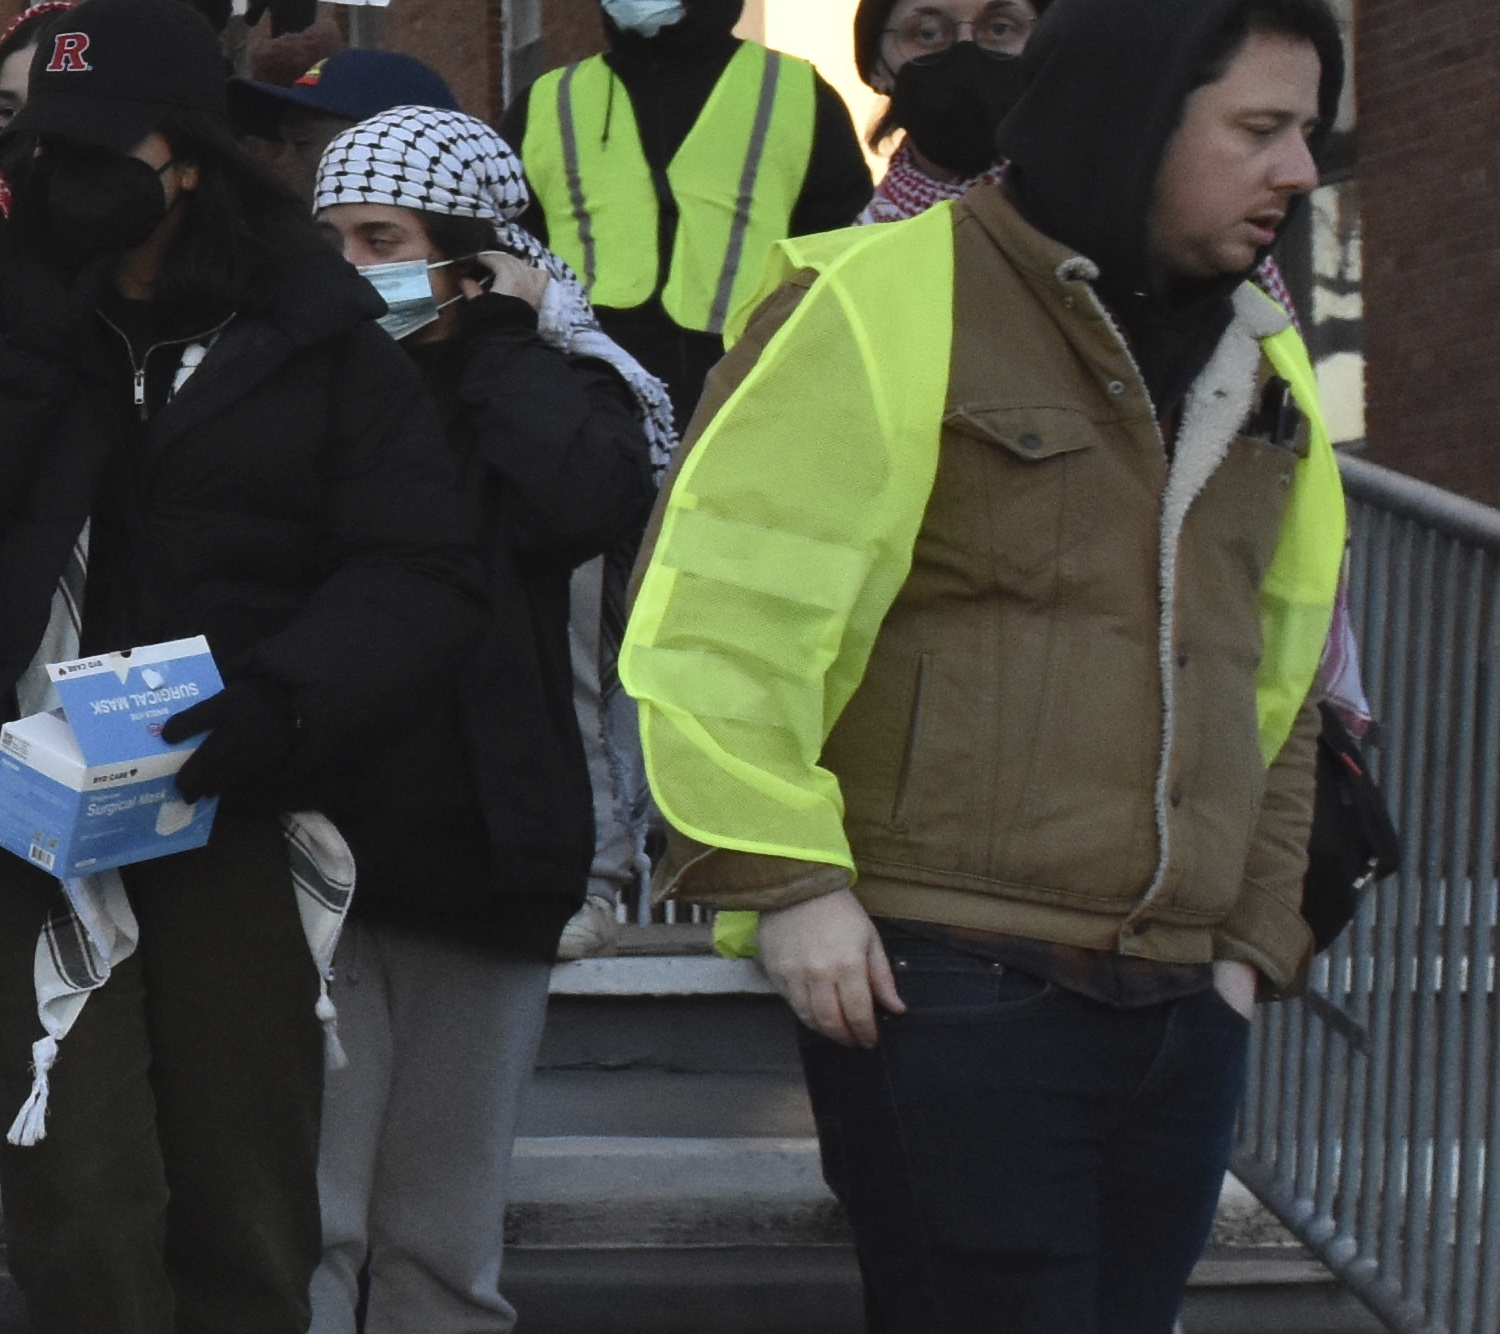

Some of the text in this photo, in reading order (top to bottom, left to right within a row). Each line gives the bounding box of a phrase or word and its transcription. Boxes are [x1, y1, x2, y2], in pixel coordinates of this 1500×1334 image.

[46, 32, 90, 71] R
[89, 682, 200, 716] SURGICAL MASK
